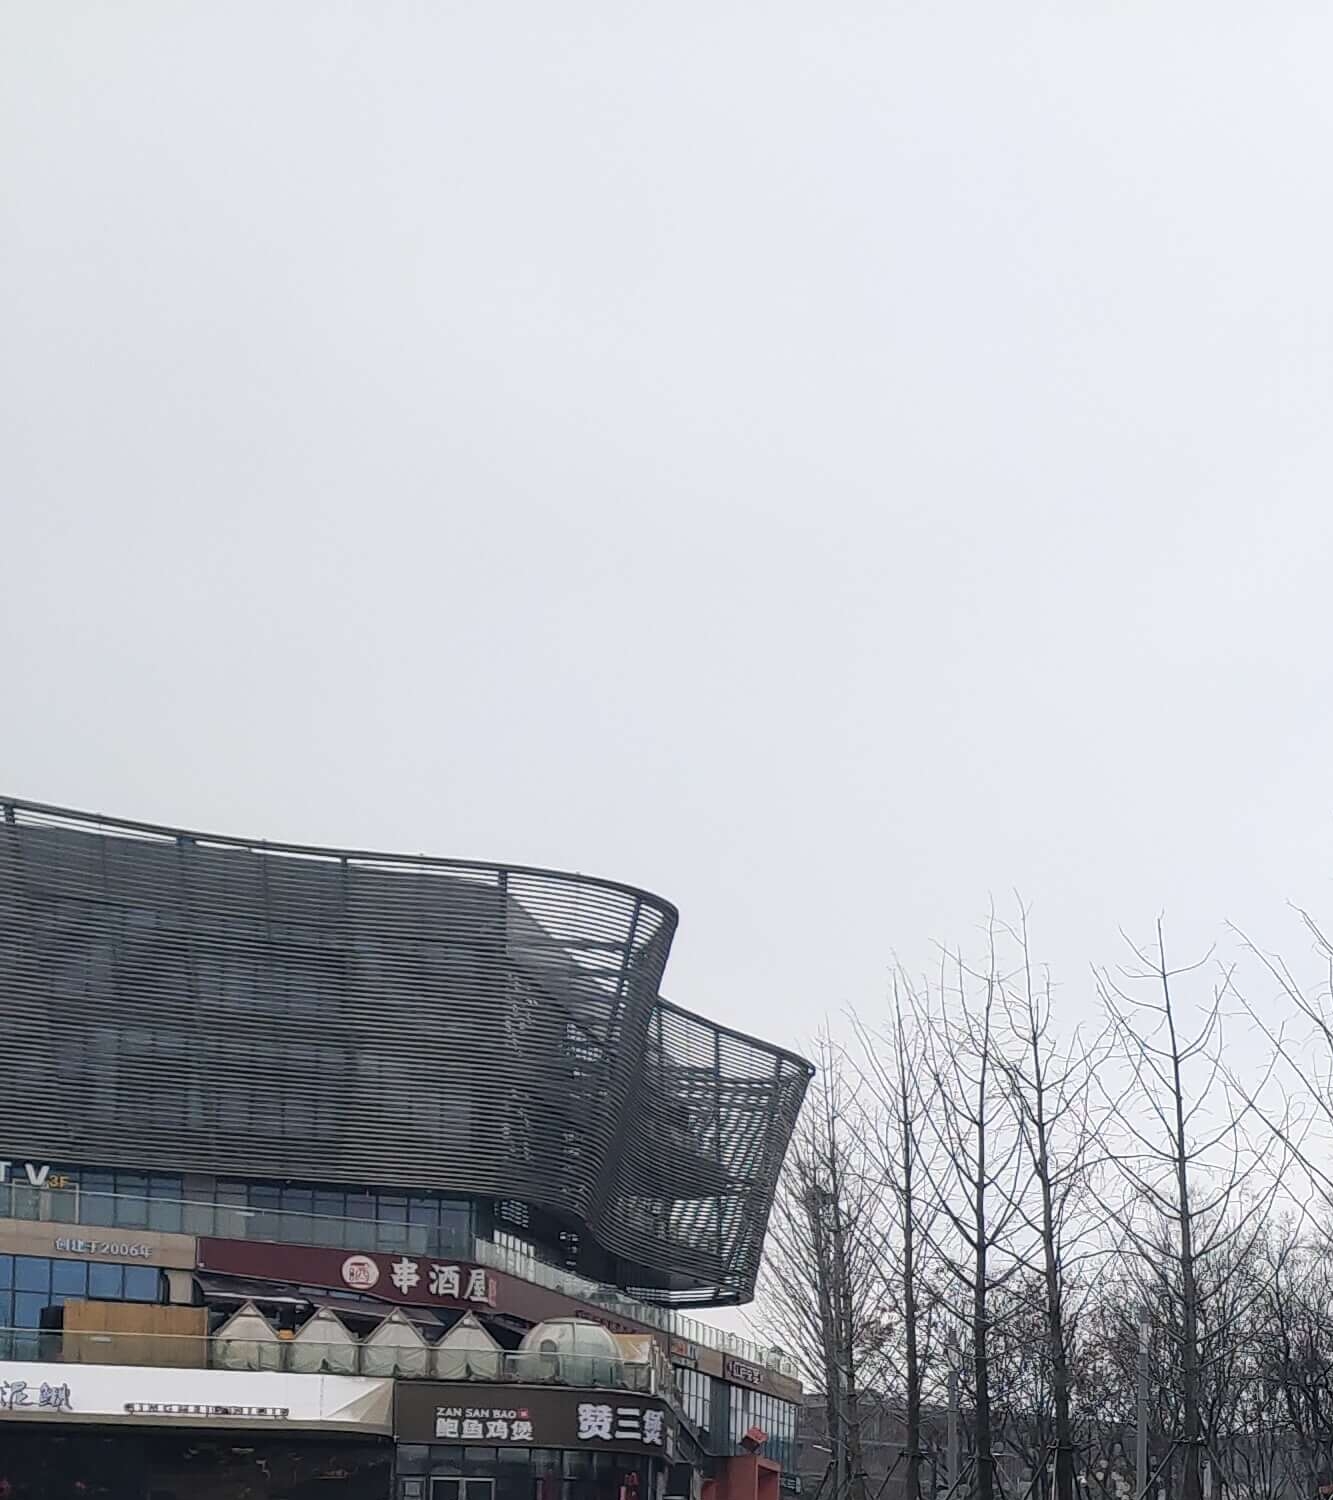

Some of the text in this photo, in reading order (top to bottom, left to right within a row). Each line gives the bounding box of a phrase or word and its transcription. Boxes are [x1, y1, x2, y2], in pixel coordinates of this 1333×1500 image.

[56, 1237, 151, 1258] 创建于2006年
[390, 1257, 489, 1303] 串酒屋
[436, 1407, 517, 1420] ZAN SAN BAO
[436, 1418, 534, 1441] 鲍鱼鸡煲
